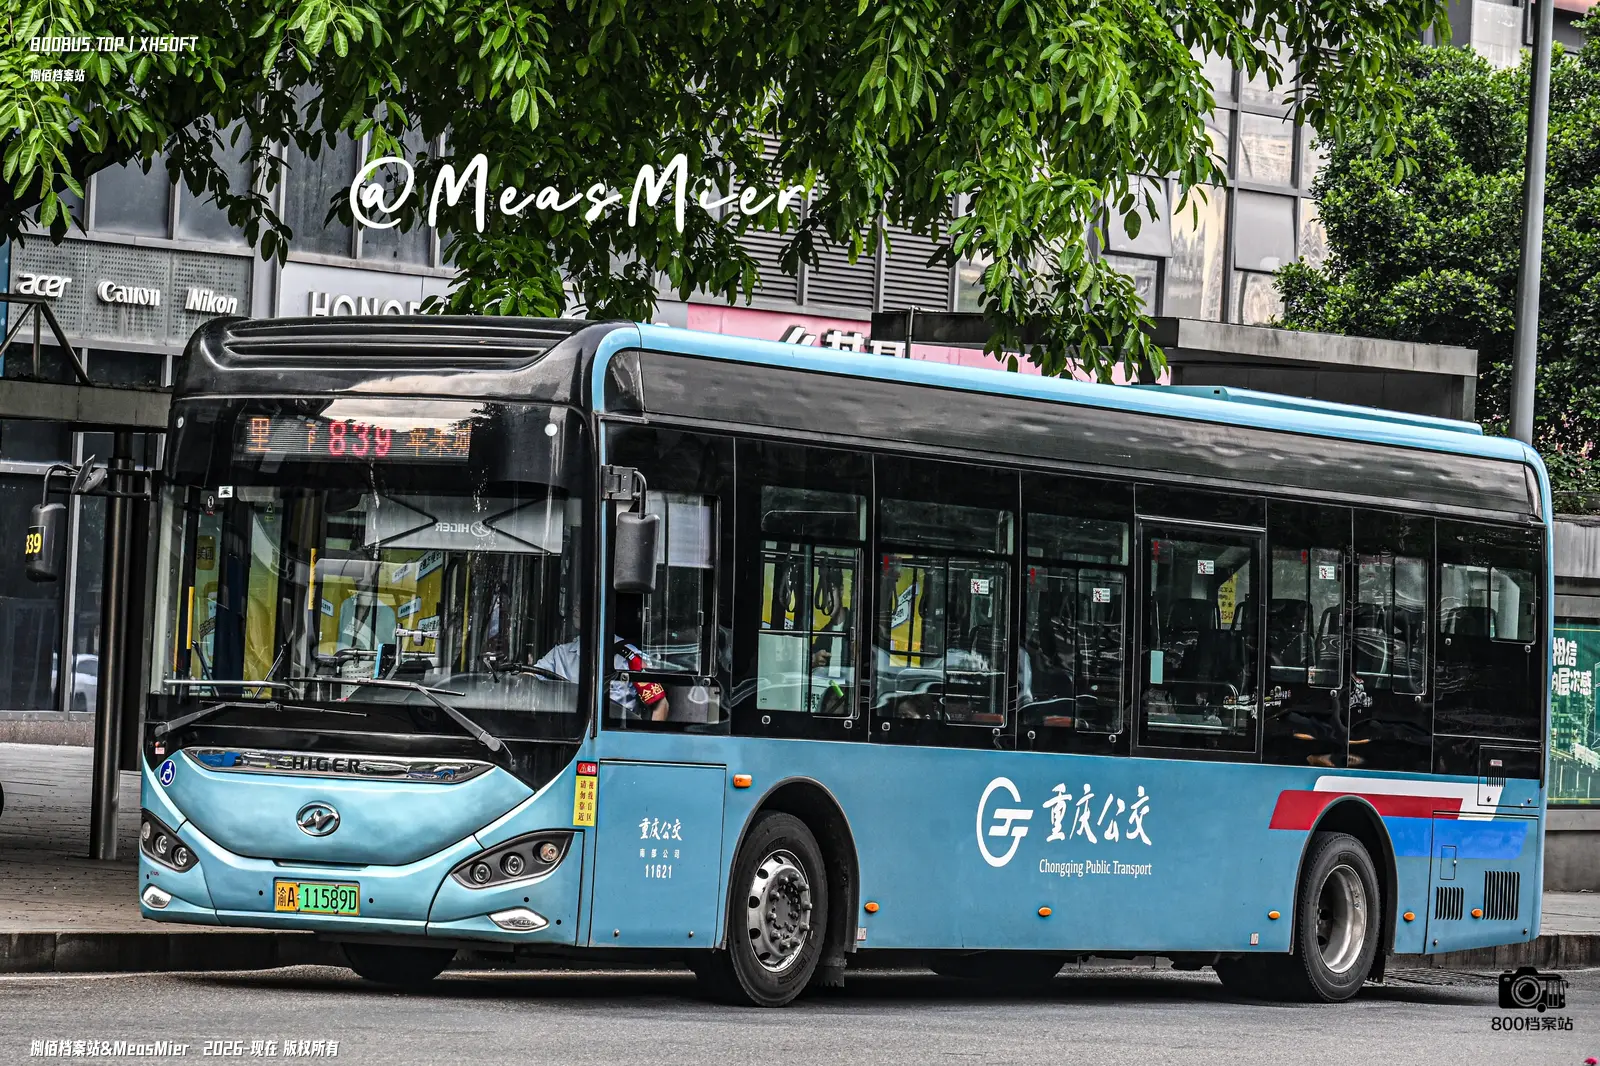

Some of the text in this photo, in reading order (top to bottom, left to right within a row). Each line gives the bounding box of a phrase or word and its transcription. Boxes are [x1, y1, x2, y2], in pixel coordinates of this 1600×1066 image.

[16, 273, 72, 298] acer
[97, 281, 161, 306] Canon
[185, 288, 238, 314] Nikon
[328, 420, 391, 456] 839
[292, 755, 361, 774] HIGER
[1042, 782, 1152, 846] 重庆公交
[638, 817, 683, 841] 重庆公交
[645, 864, 672, 879] 11621
[1039, 858, 1153, 878] Chongqing Public Transport
